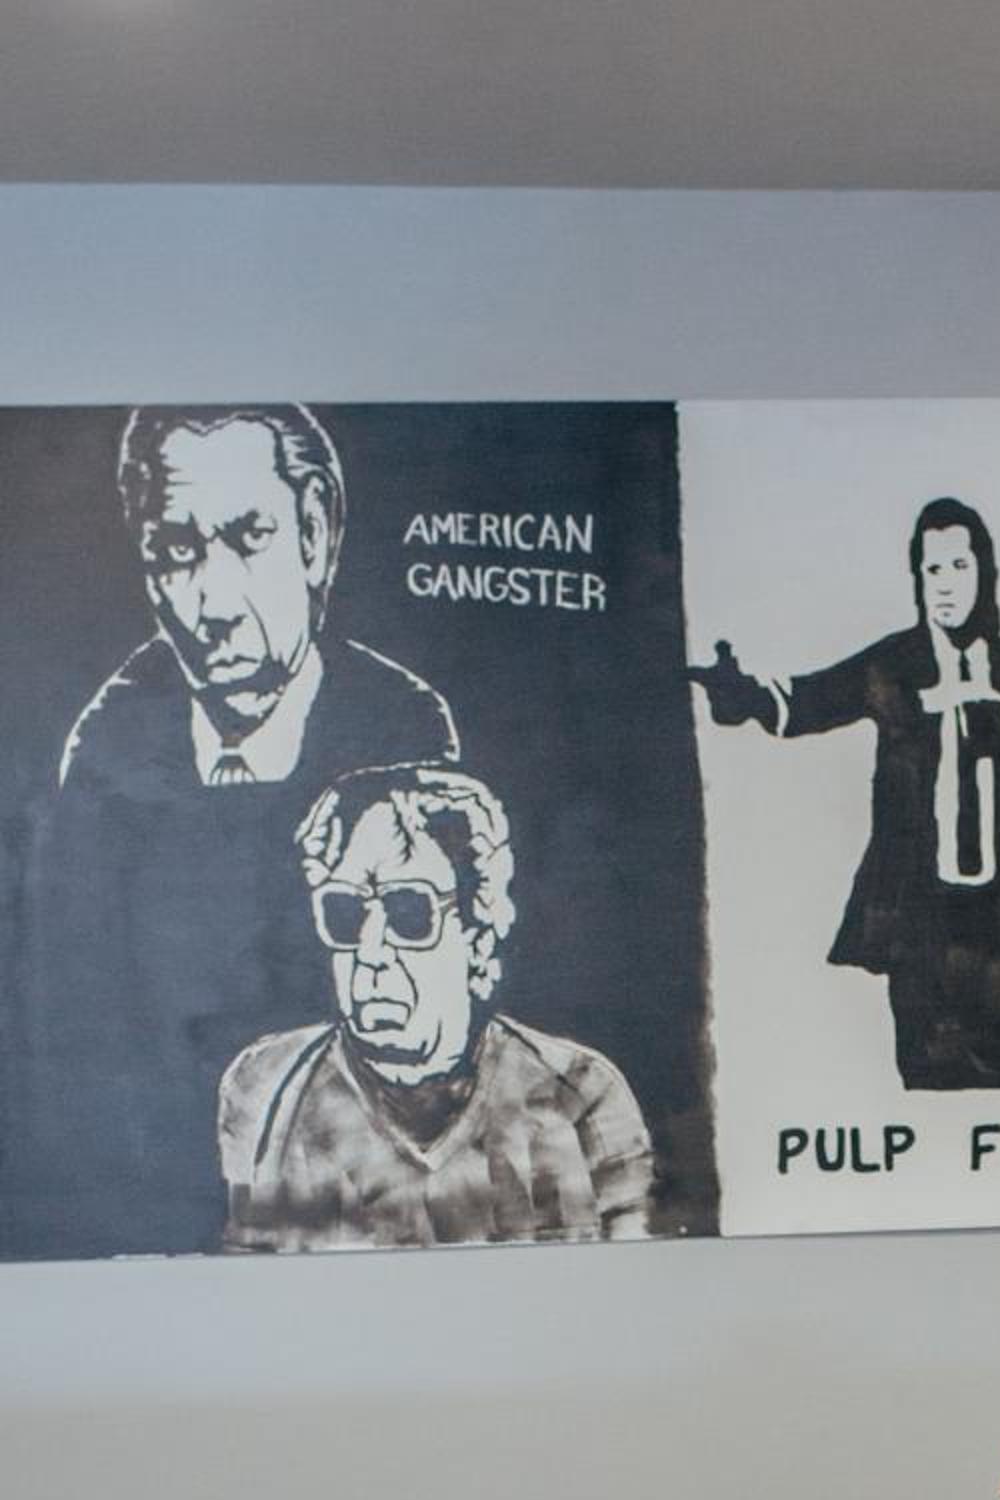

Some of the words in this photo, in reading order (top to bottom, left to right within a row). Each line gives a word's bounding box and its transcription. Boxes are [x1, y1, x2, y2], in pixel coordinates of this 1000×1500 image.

[403, 512, 593, 552] AMERICAN
[406, 563, 606, 611] GANGSTER
[778, 1125, 916, 1174] PULP
